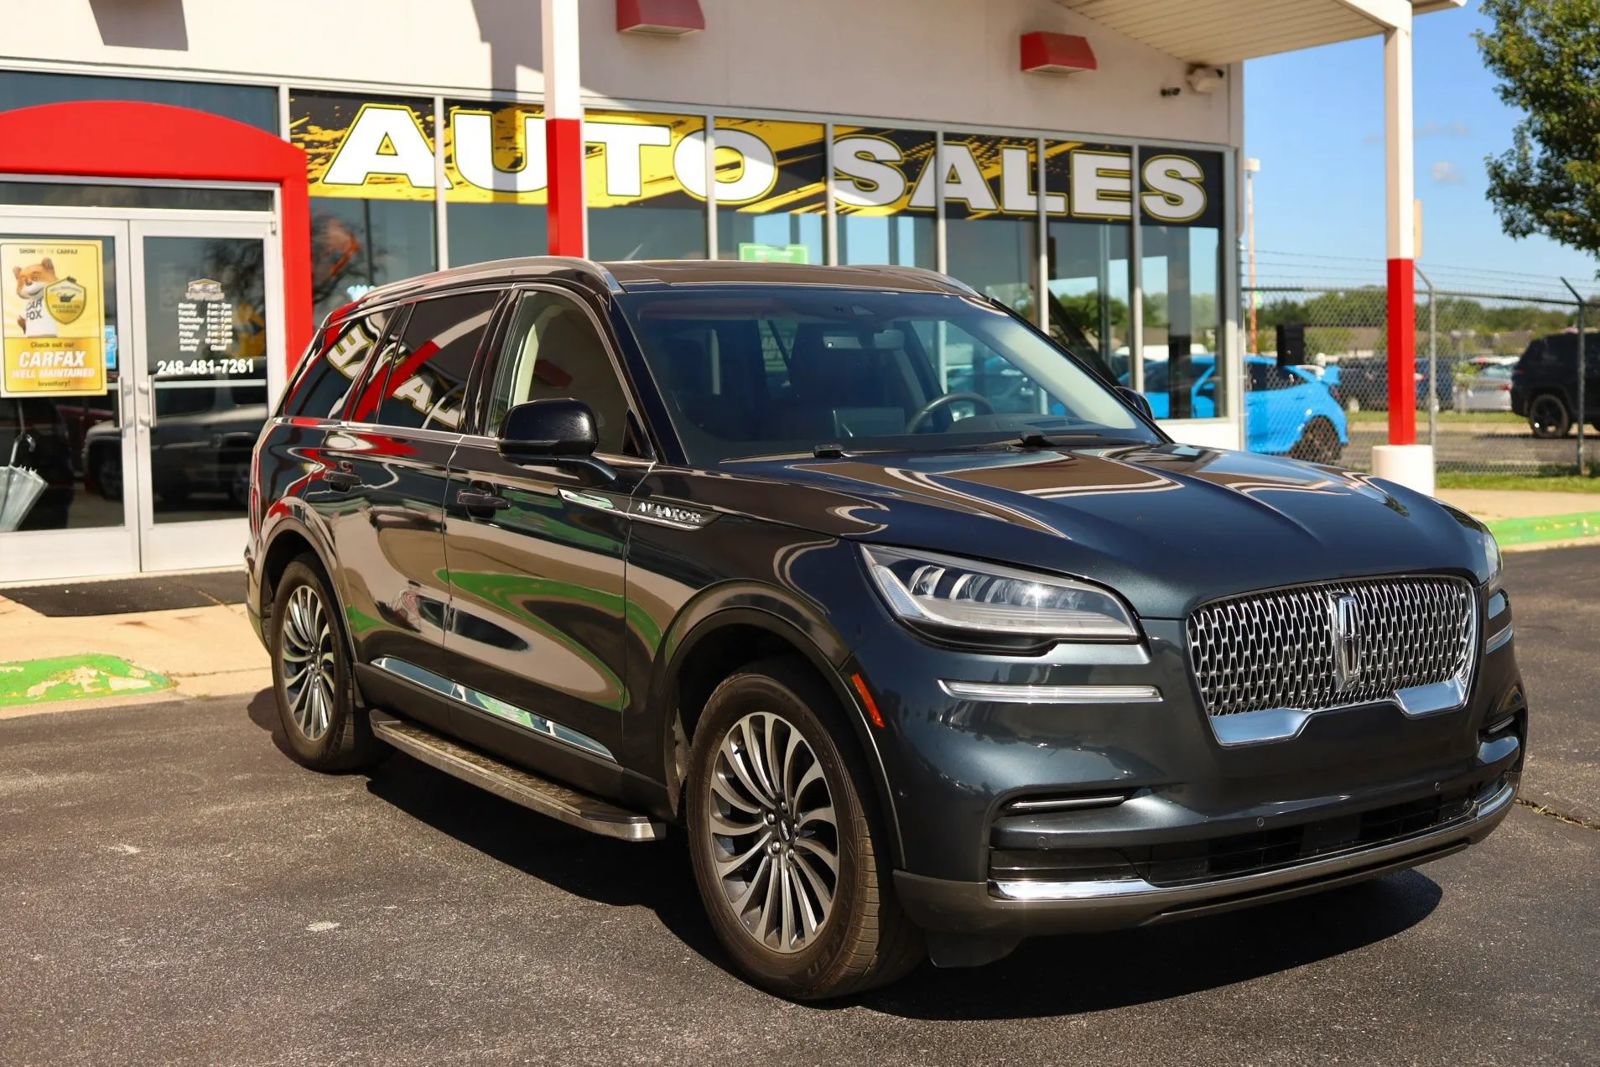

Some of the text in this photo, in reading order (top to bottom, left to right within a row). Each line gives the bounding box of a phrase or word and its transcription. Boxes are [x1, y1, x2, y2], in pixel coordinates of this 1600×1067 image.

[321, 103, 1207, 221] AUTO SALES
[19, 350, 87, 368] CARFAX
[157, 358, 255, 375] 248-481-7261
